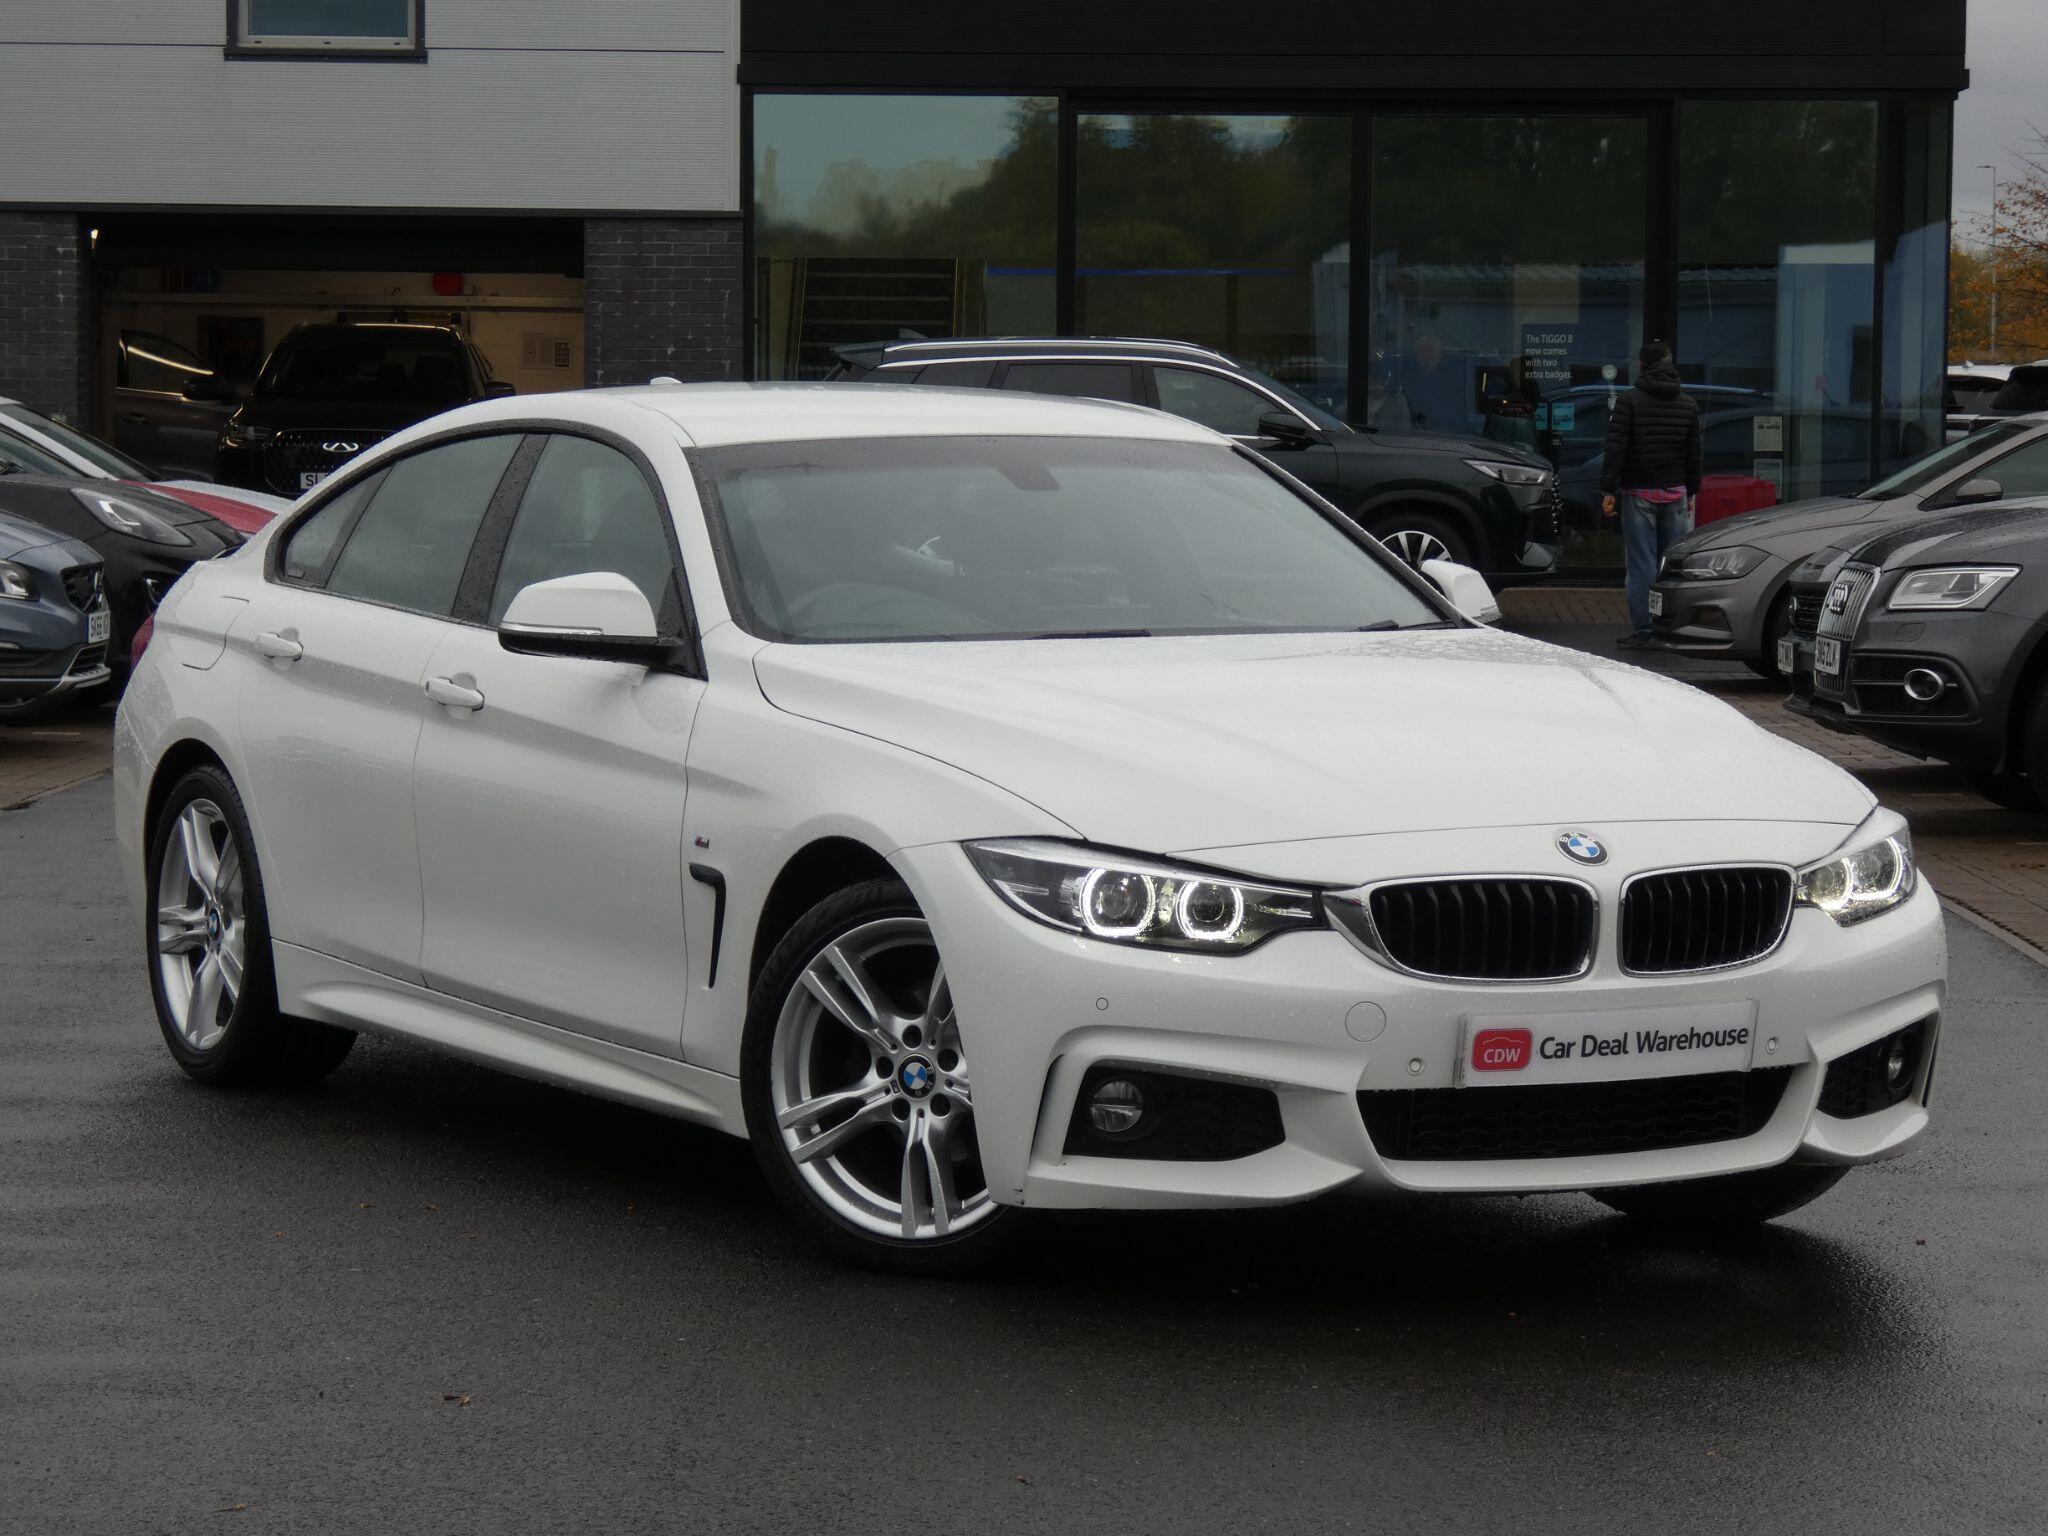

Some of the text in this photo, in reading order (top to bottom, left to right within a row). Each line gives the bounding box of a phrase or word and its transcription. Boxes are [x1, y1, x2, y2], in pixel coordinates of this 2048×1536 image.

[1526, 334, 1539, 343] The
[1567, 334, 1573, 343] 8
[1525, 358, 1558, 367] with two
[1540, 1026, 1749, 1059] Car Deal Warehouse
[1483, 1048, 1521, 1063] CDW
